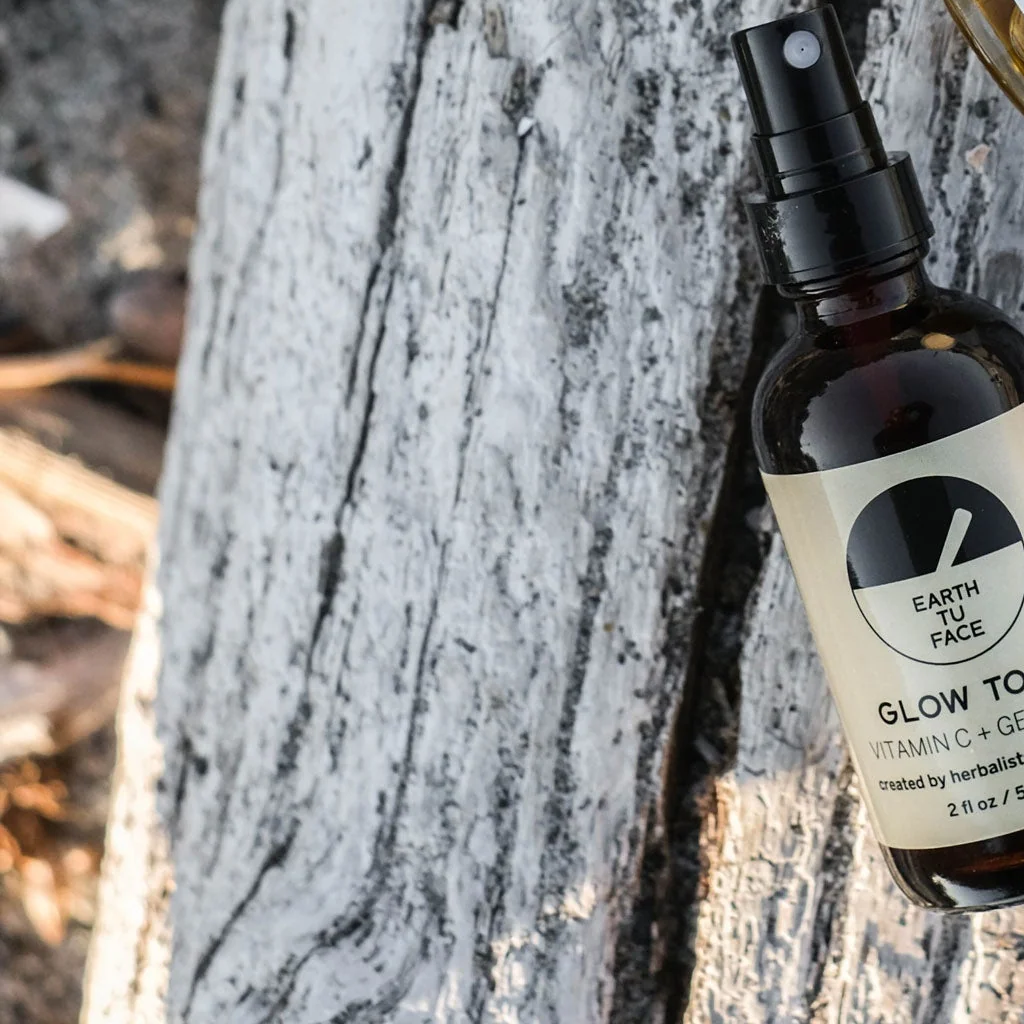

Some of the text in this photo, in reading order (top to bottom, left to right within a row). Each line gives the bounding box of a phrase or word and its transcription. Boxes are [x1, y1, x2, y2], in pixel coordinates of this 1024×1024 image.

[912, 579, 980, 613] EARTH
[936, 605, 966, 626] TU
[930, 620, 985, 649] FACE
[878, 685, 968, 725] GLOW
[869, 733, 950, 759] VITAMIN
[955, 728, 971, 748] C
[978, 727, 991, 740] +
[879, 775, 925, 791] created
[927, 774, 946, 789] by
[947, 803, 959, 817] 2
[961, 799, 973, 814] fl
[977, 797, 998, 810] oz
